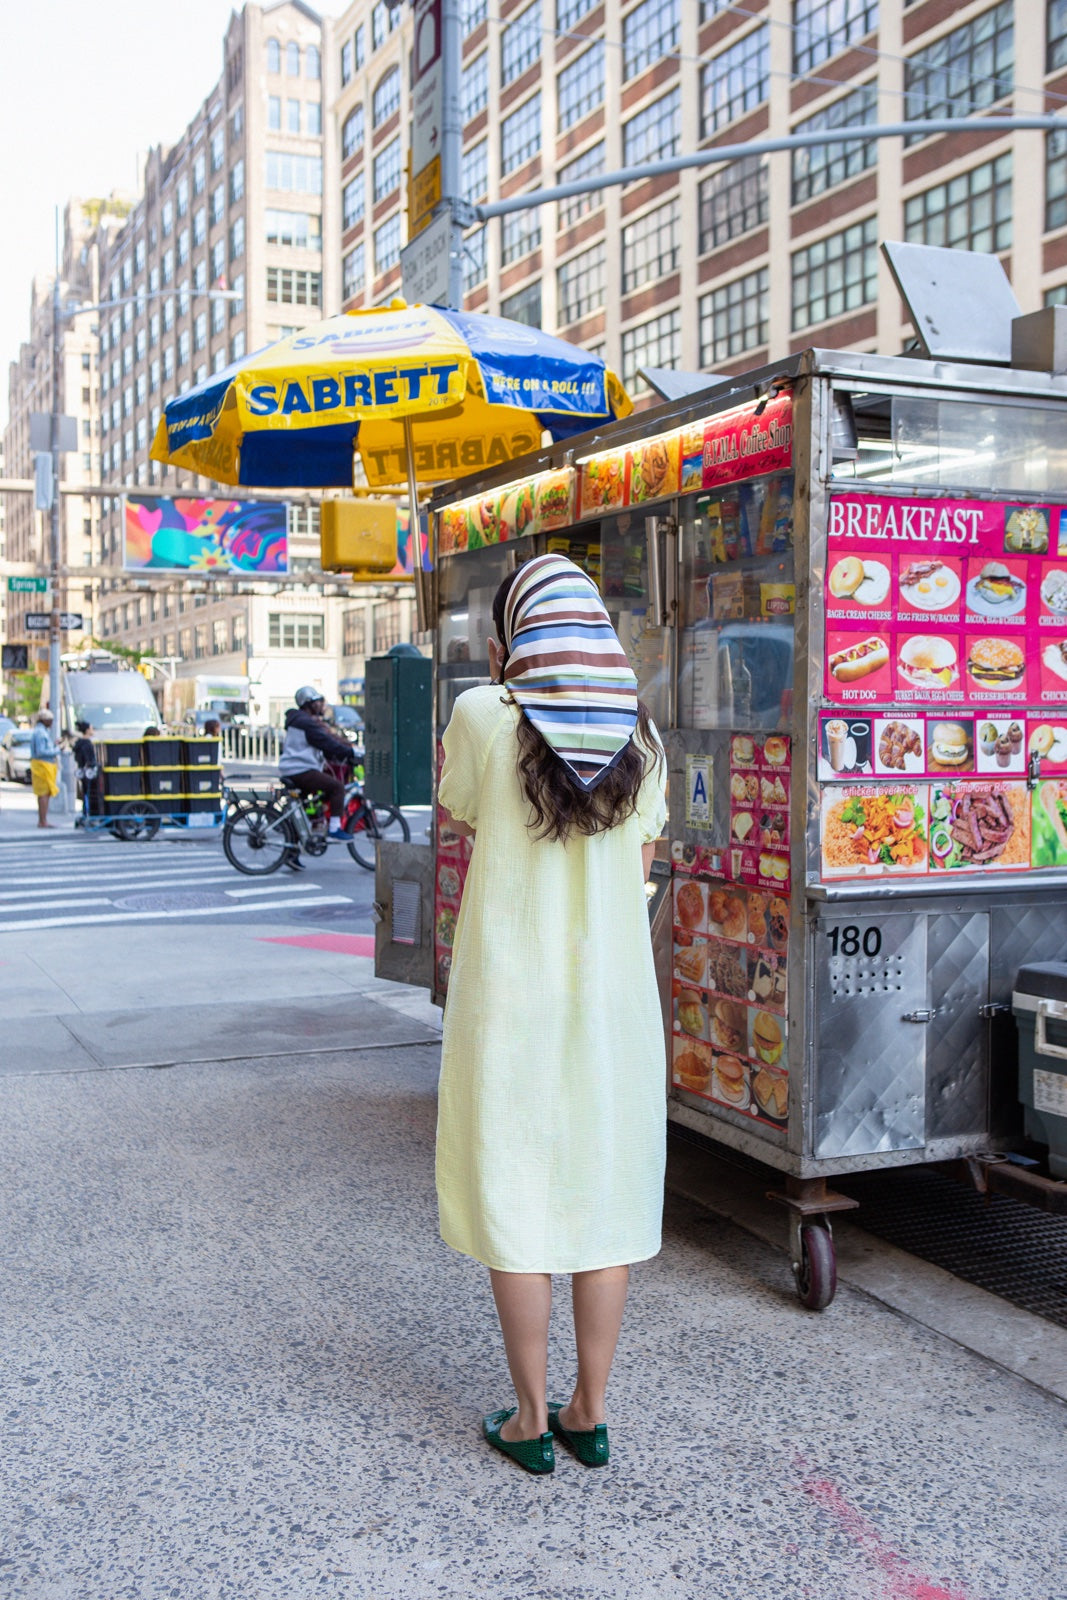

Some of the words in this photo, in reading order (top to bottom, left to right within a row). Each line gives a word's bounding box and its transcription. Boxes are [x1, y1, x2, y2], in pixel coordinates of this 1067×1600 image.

[425, 231, 447, 266] BLOCK
[426, 264, 439, 290] BOX
[291, 319, 430, 351] SABRETT
[246, 361, 459, 417] SABRETT
[522, 377, 540, 392] ON
[551, 380, 580, 395] ROLL
[740, 422, 768, 459] Coffee
[768, 417, 792, 454] Shop
[828, 501, 984, 544] BREAKFAST
[11, 577, 37, 592] Spring
[766, 600, 790, 611] LIPTON
[827, 609, 845, 619] BAGEL
[845, 609, 867, 620] CREAM
[867, 610, 892, 621] CHEESE
[897, 611, 911, 621] EGG
[911, 612, 929, 622] FRIES
[842, 689, 859, 700] HOT
[859, 689, 877, 700] DOG
[969, 691, 1027, 702] CHEESEBURGER
[692, 770, 708, 804] A
[841, 785, 877, 797] Chicken
[878, 786, 898, 796] over
[899, 784, 919, 796] Rice
[950, 781, 974, 793] Lamb
[974, 782, 993, 793] over
[993, 781, 1012, 792] Rice
[826, 925, 882, 957] 180
